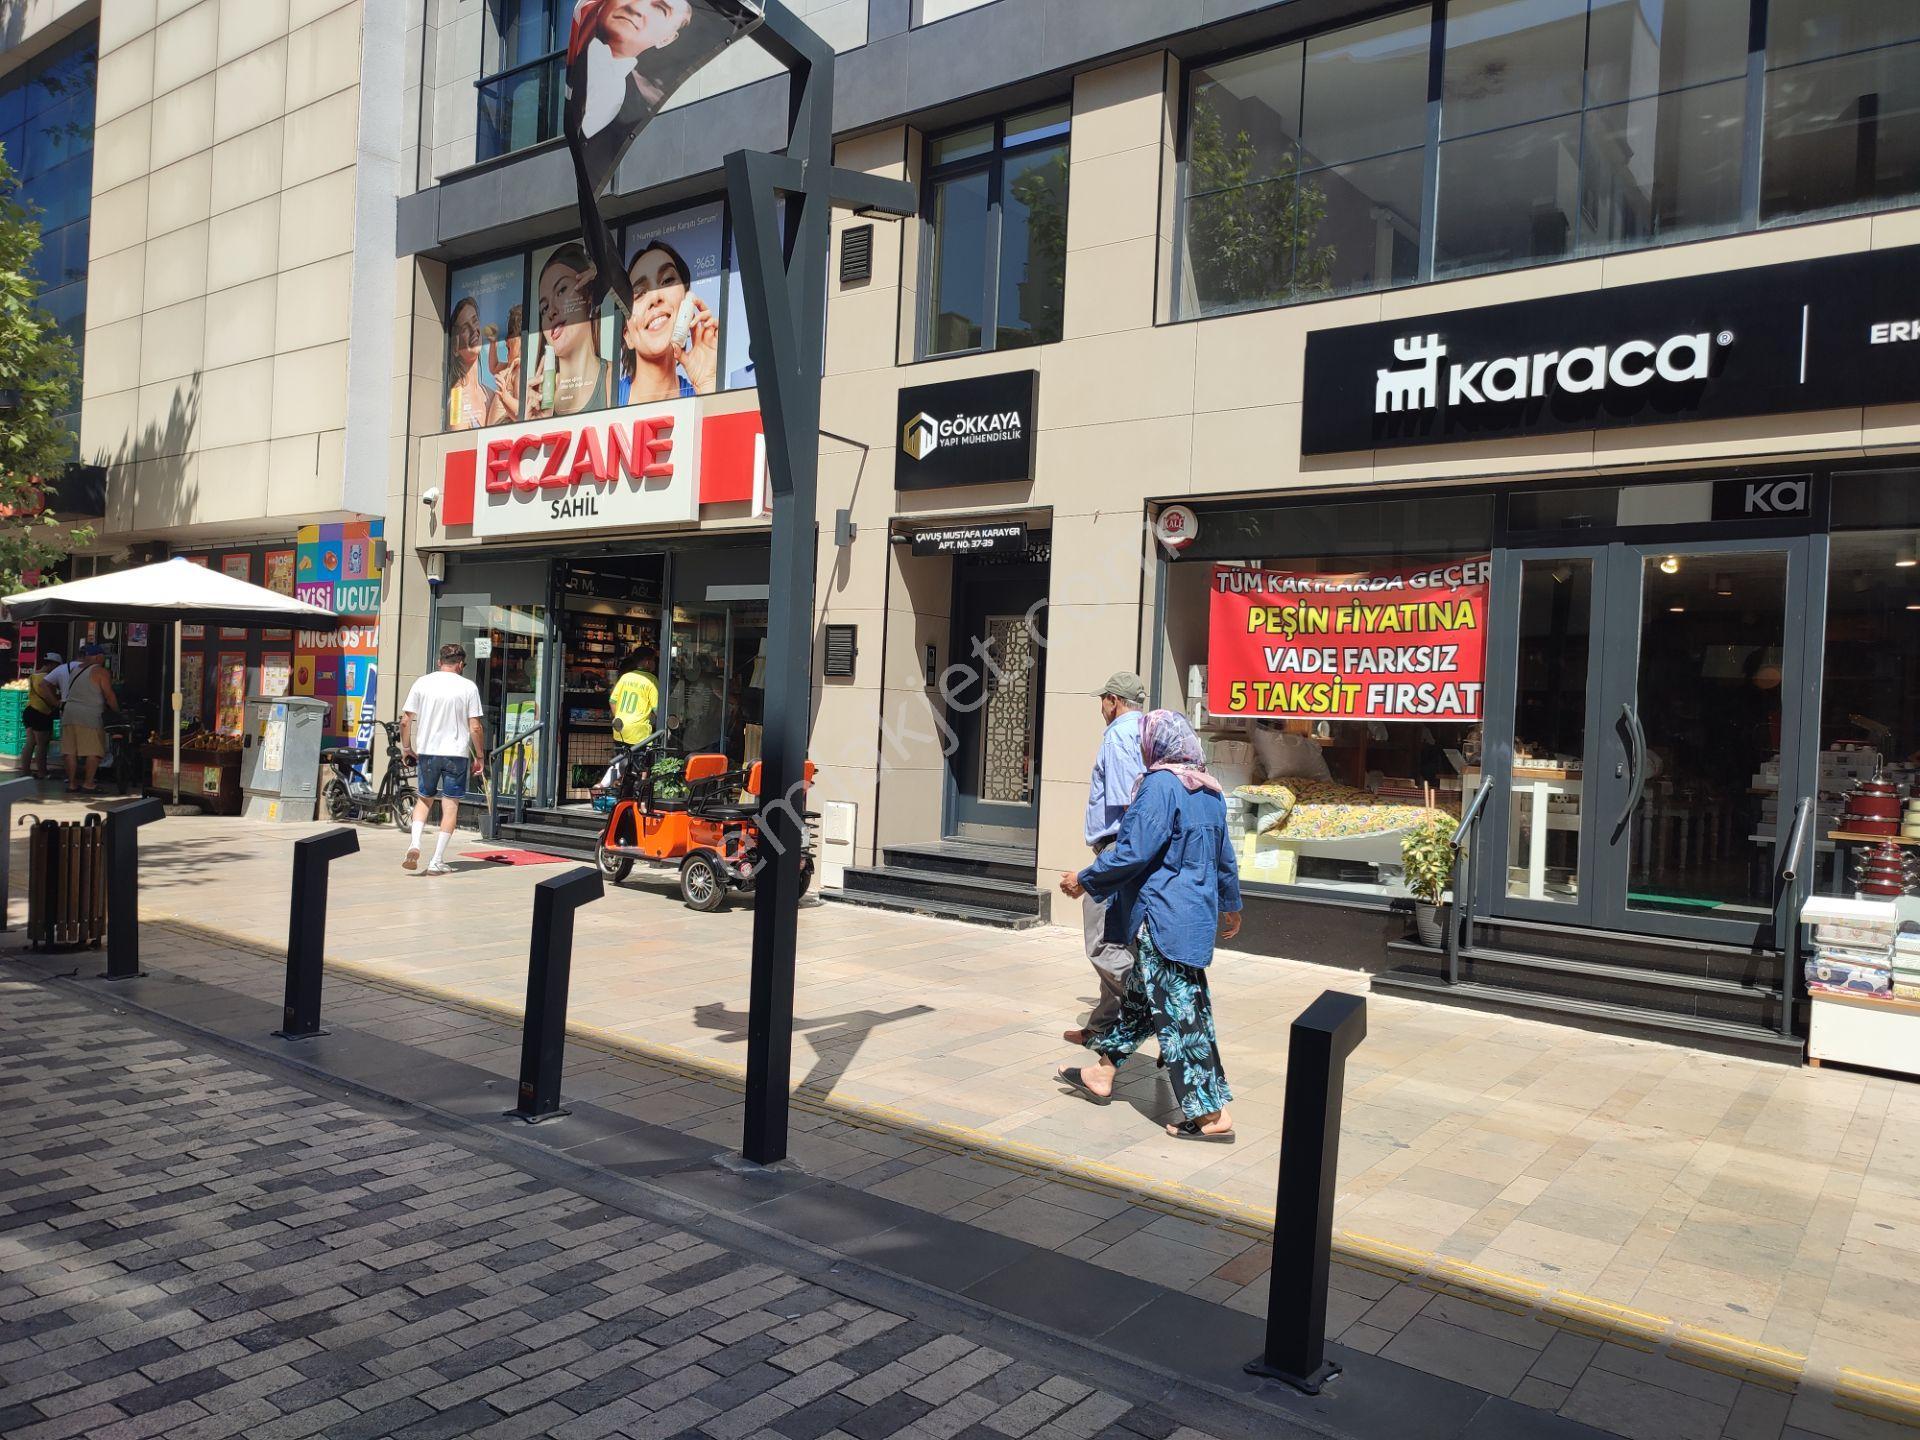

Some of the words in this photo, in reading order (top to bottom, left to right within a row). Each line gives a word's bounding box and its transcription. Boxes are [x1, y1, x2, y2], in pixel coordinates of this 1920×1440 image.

[1448, 333, 1710, 406] karaca
[939, 411, 1021, 437] GÖKKAYA
[939, 437, 959, 447] YAPI
[961, 429, 1021, 446] MÜHENDİSLİK
[485, 415, 674, 493] ECZANE
[550, 491, 599, 519] SAHİL
[916, 532, 942, 542] ÇAVUŞ
[942, 529, 982, 540] MUSTAFA
[982, 527, 1021, 537] KARAYER
[938, 540, 955, 549] APT.
[971, 538, 994, 547] 37-39
[1216, 568, 1264, 593] TÜM
[1267, 574, 1405, 593] KARTLARDA
[1408, 561, 1491, 592] GEÇER
[336, 586, 380, 612] UCUZ
[1248, 599, 1329, 641] PEŞİN
[1335, 598, 1477, 634] FİYATINA
[1263, 646, 1337, 674] VADE
[1342, 644, 1458, 673] FARKSIZ
[620, 690, 639, 714] 10
[1229, 681, 1247, 711] 5
[1252, 675, 1363, 714] TAKSİT
[1366, 681, 1484, 715] FIRSAT
